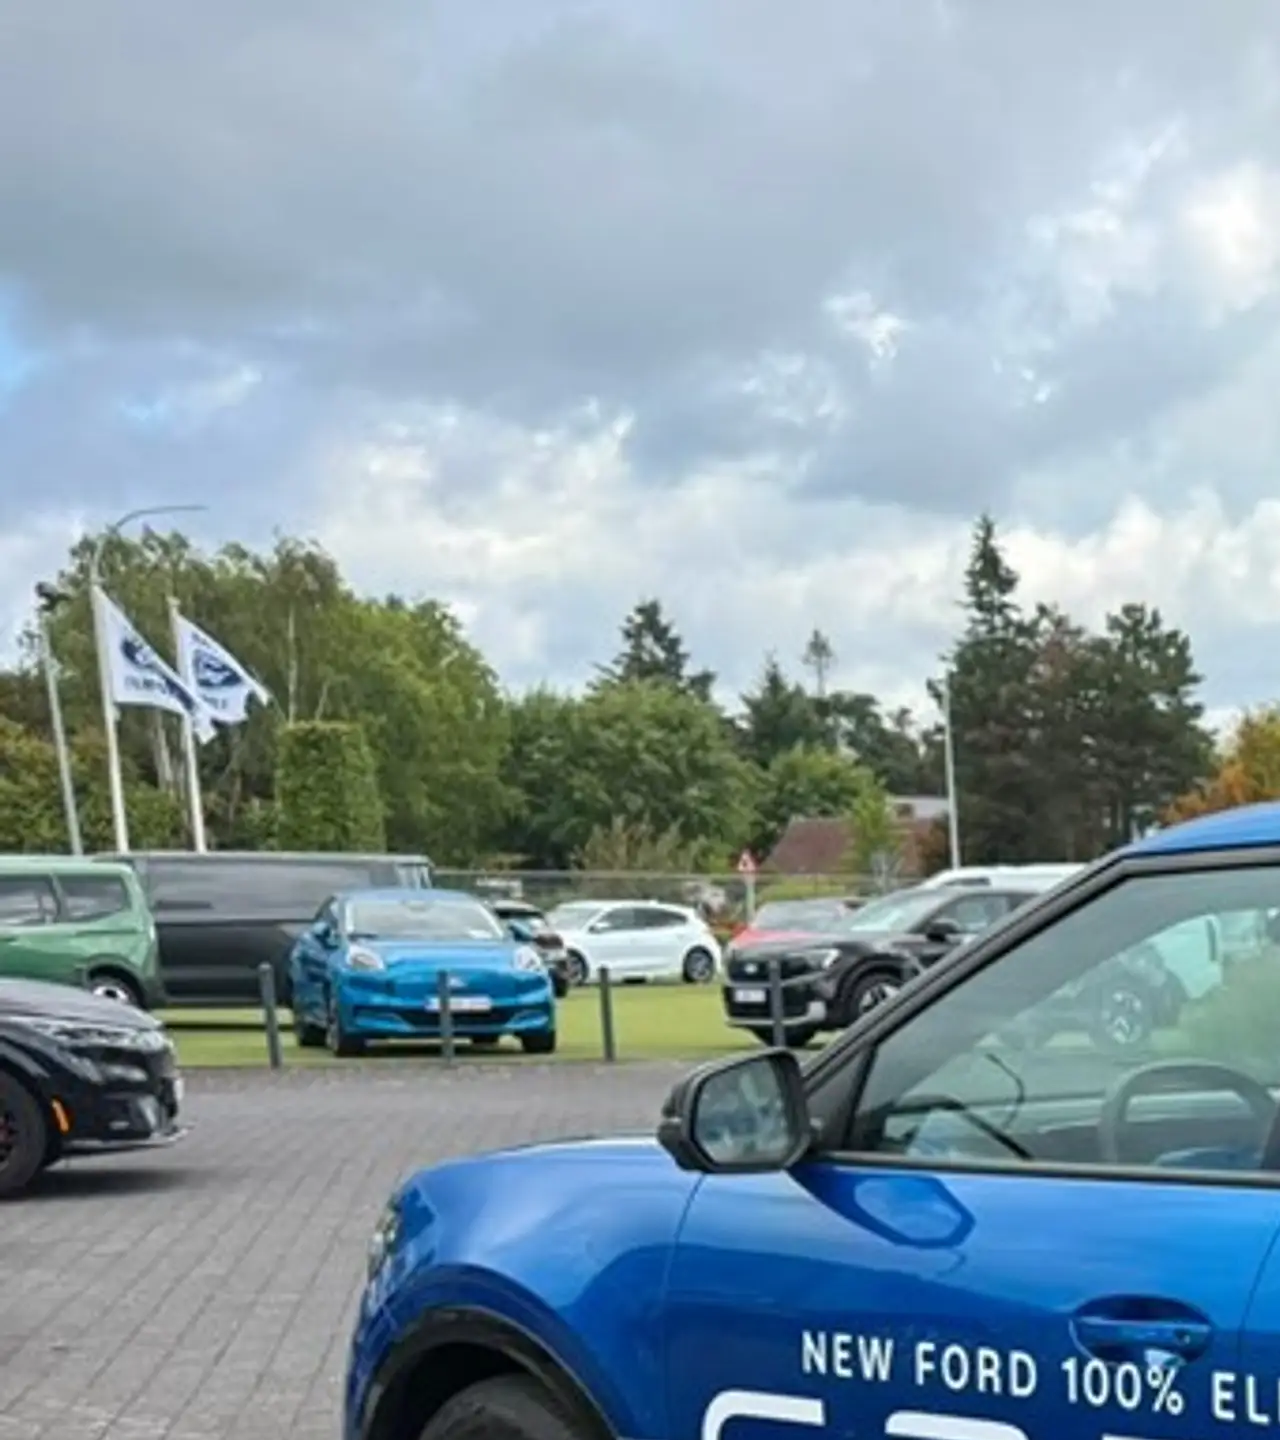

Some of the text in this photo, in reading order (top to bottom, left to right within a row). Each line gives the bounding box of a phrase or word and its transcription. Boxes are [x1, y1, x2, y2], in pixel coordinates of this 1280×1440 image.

[801, 1329, 893, 1382] NEW
[914, 1340, 1037, 1397] FORD
[1062, 1356, 1184, 1416] 100%
